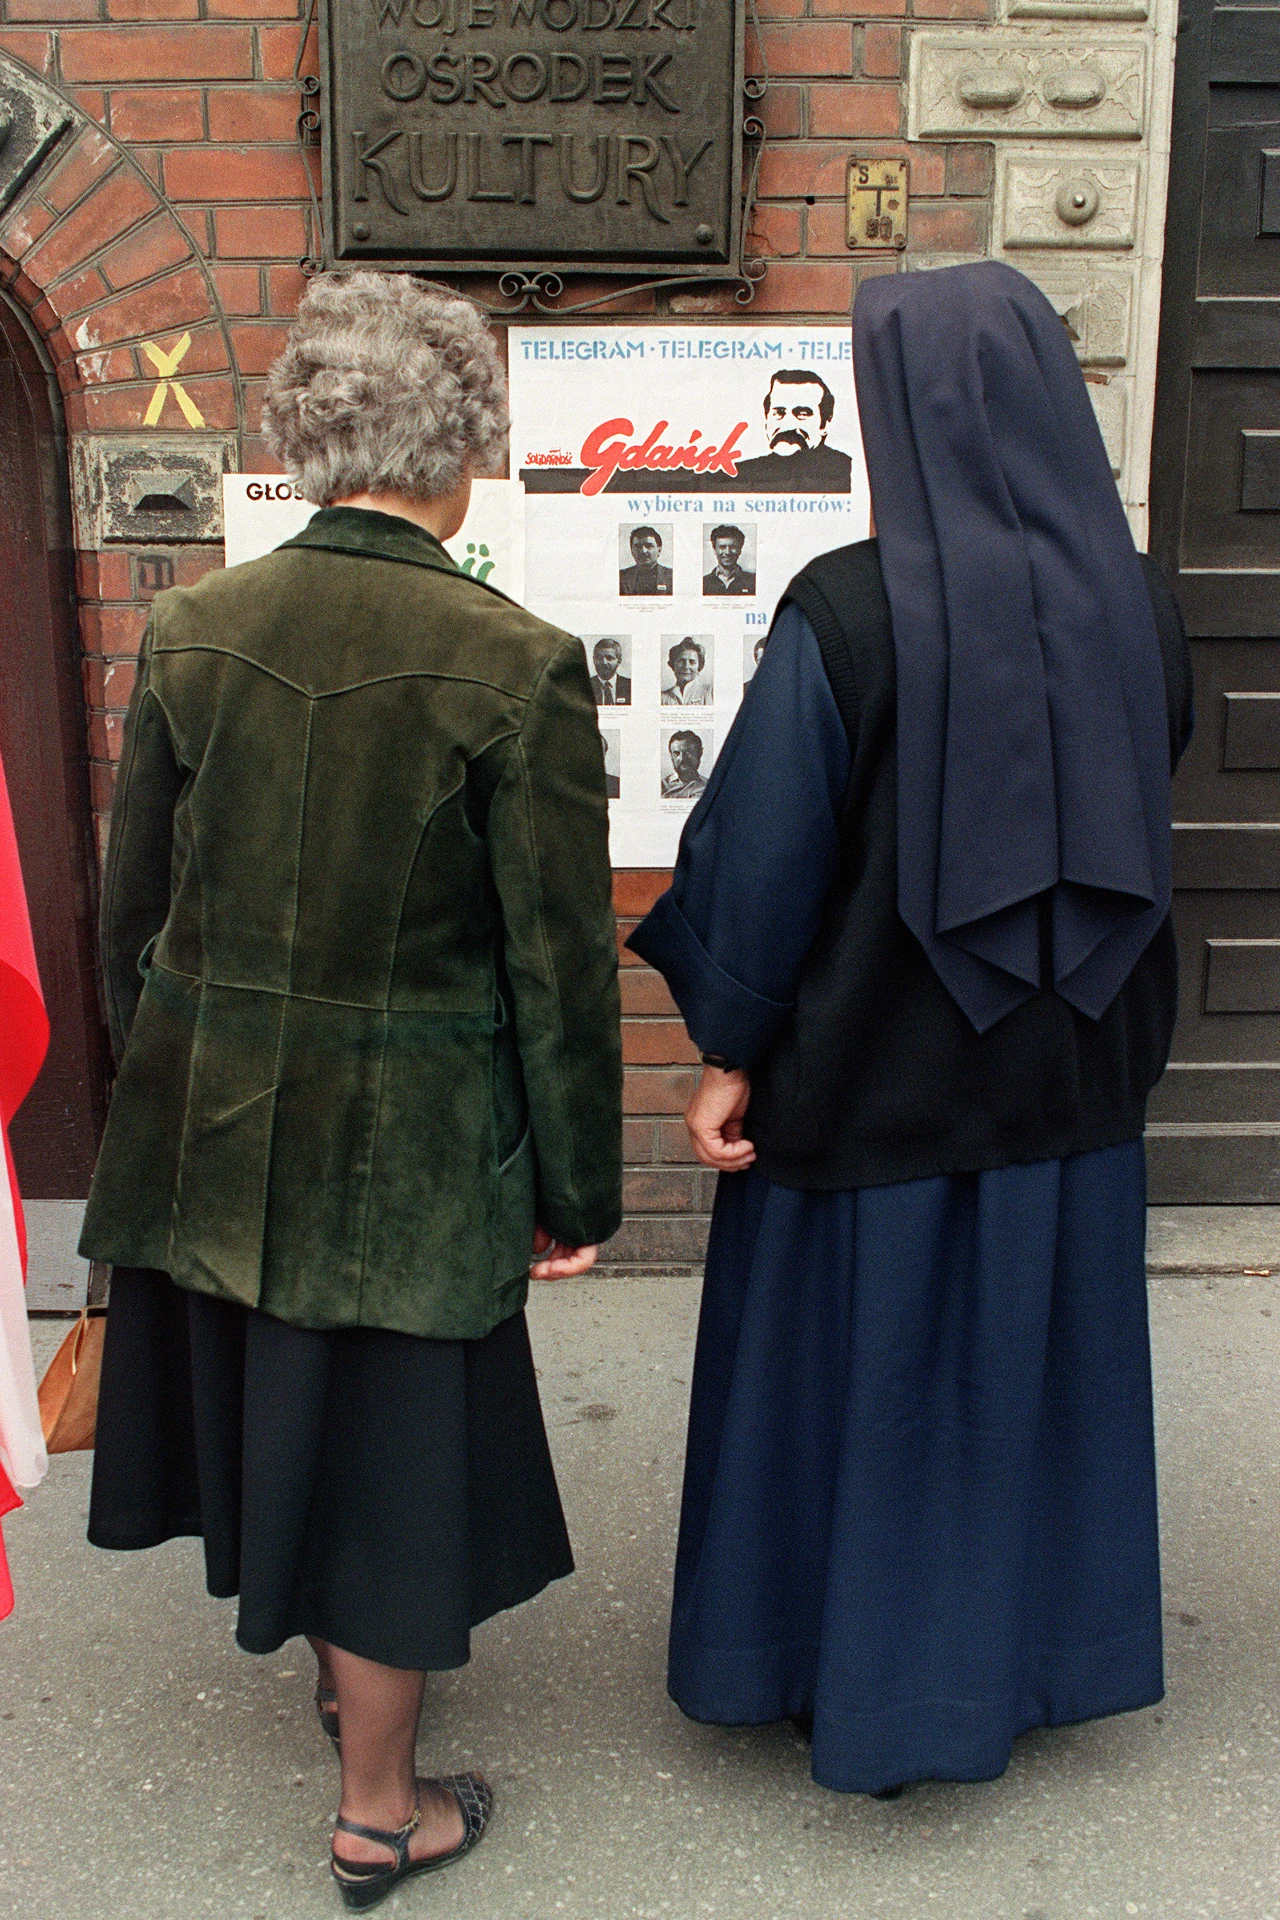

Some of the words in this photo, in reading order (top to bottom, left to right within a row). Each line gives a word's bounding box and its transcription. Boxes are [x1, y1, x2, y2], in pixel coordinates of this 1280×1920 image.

[380, 46, 680, 112] OŚRODEK
[351, 130, 714, 224] KULTURY
[520, 340, 645, 360] TELEGRAM
[659, 340, 782, 359] TELEGRAM
[798, 341, 852, 360] TELE
[580, 417, 749, 496] Gdańsk
[627, 495, 704, 517] wybiera
[713, 499, 735, 512] na
[744, 495, 851, 512] senatorów:
[745, 612, 767, 625] na
